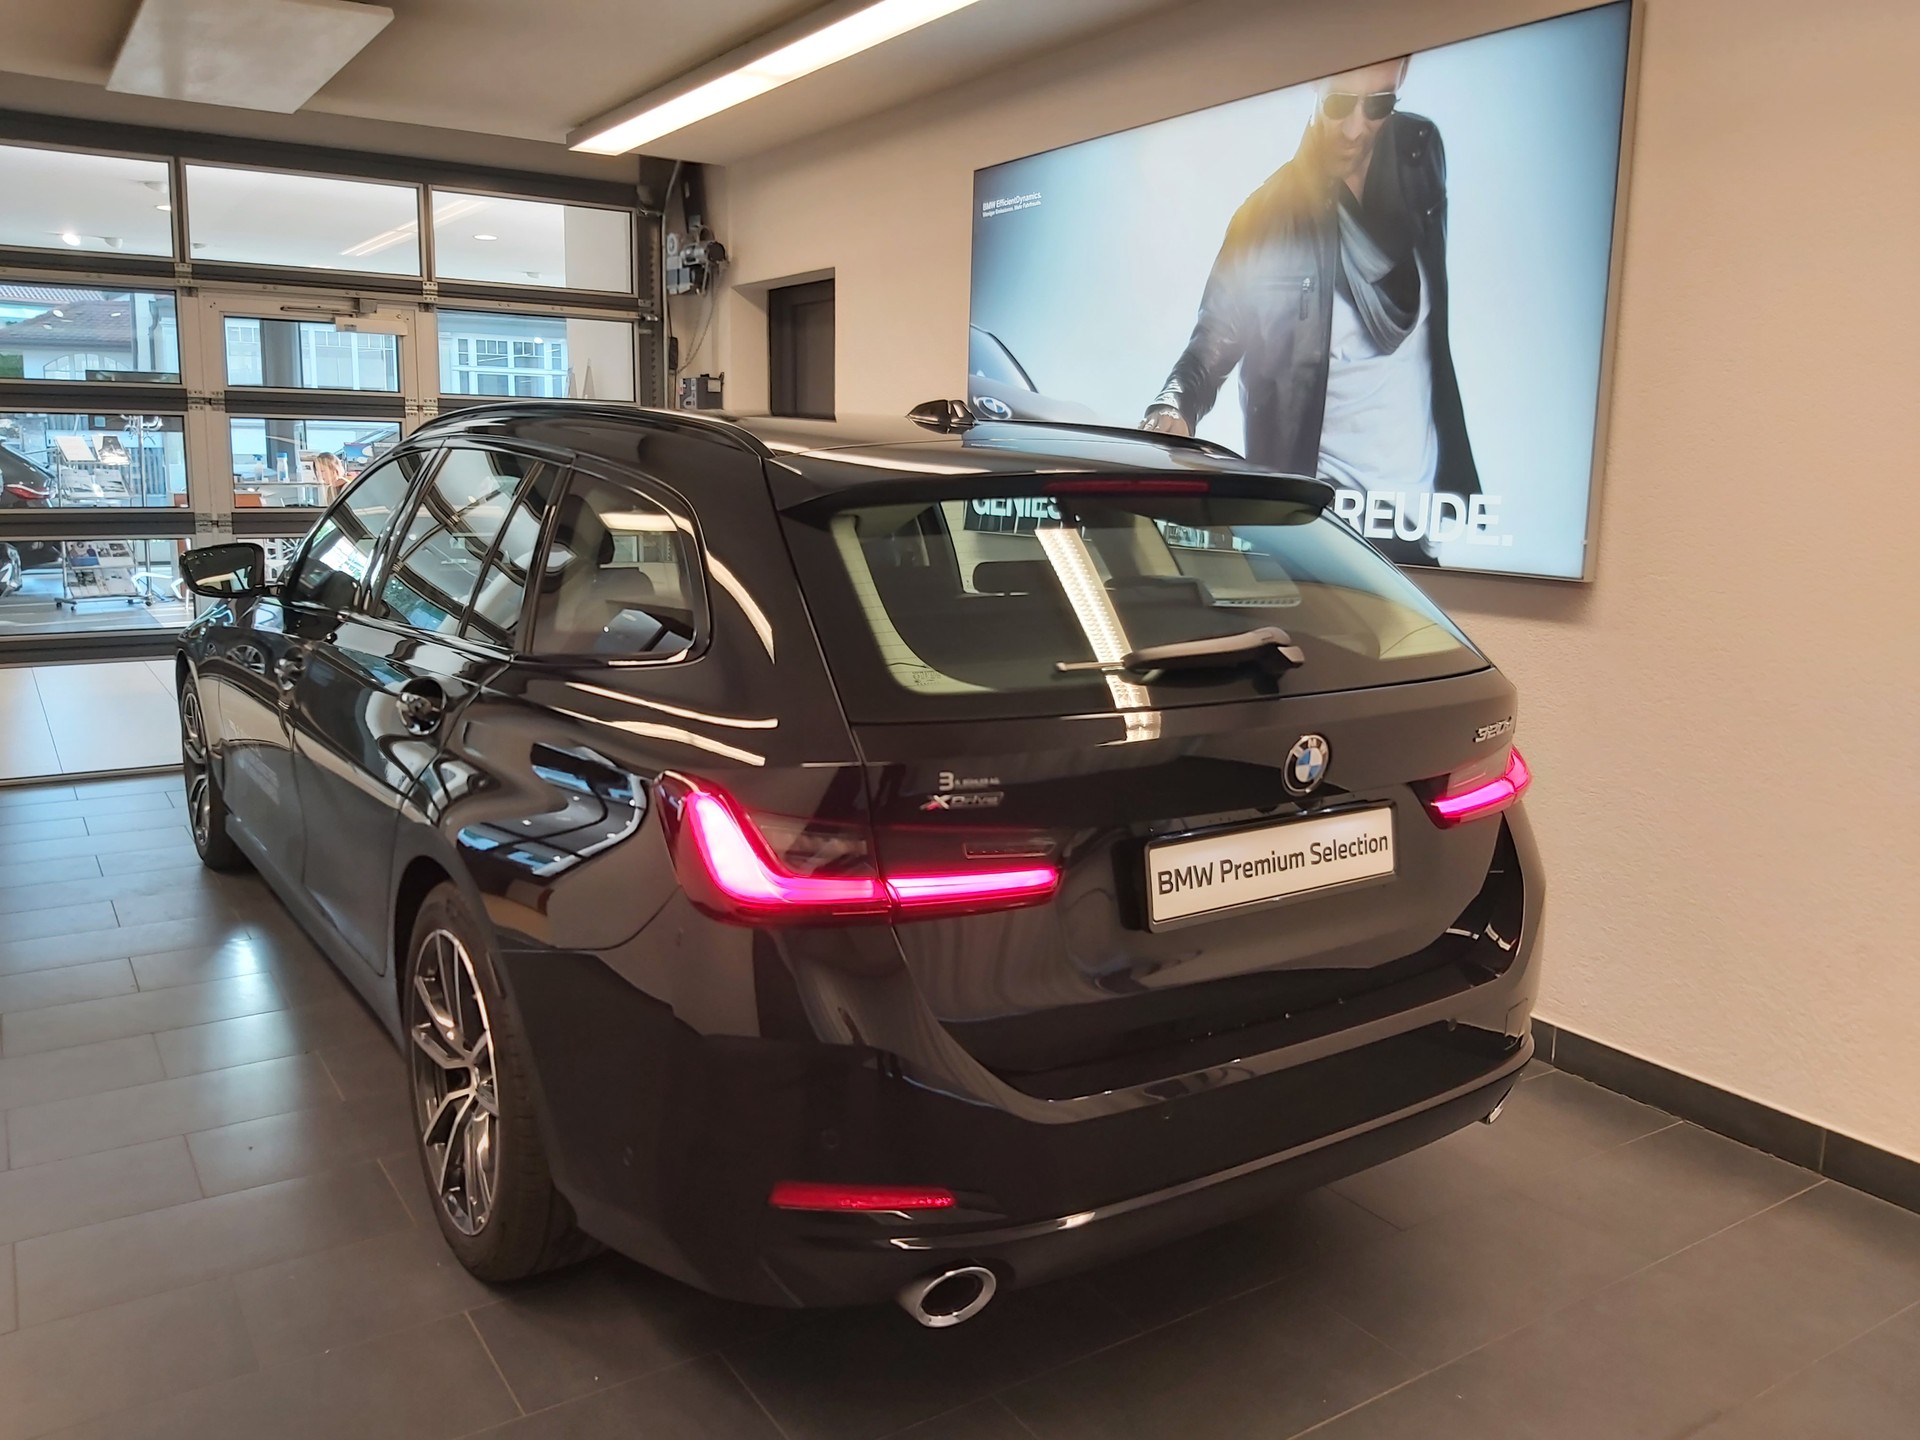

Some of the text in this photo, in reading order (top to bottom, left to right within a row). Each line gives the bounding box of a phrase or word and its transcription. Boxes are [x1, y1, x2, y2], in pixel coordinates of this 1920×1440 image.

[982, 200, 996, 211] BMW
[1329, 489, 1513, 547] REUDE.
[939, 771, 954, 791] 3
[1157, 833, 1389, 895] BMW Premium Selection
